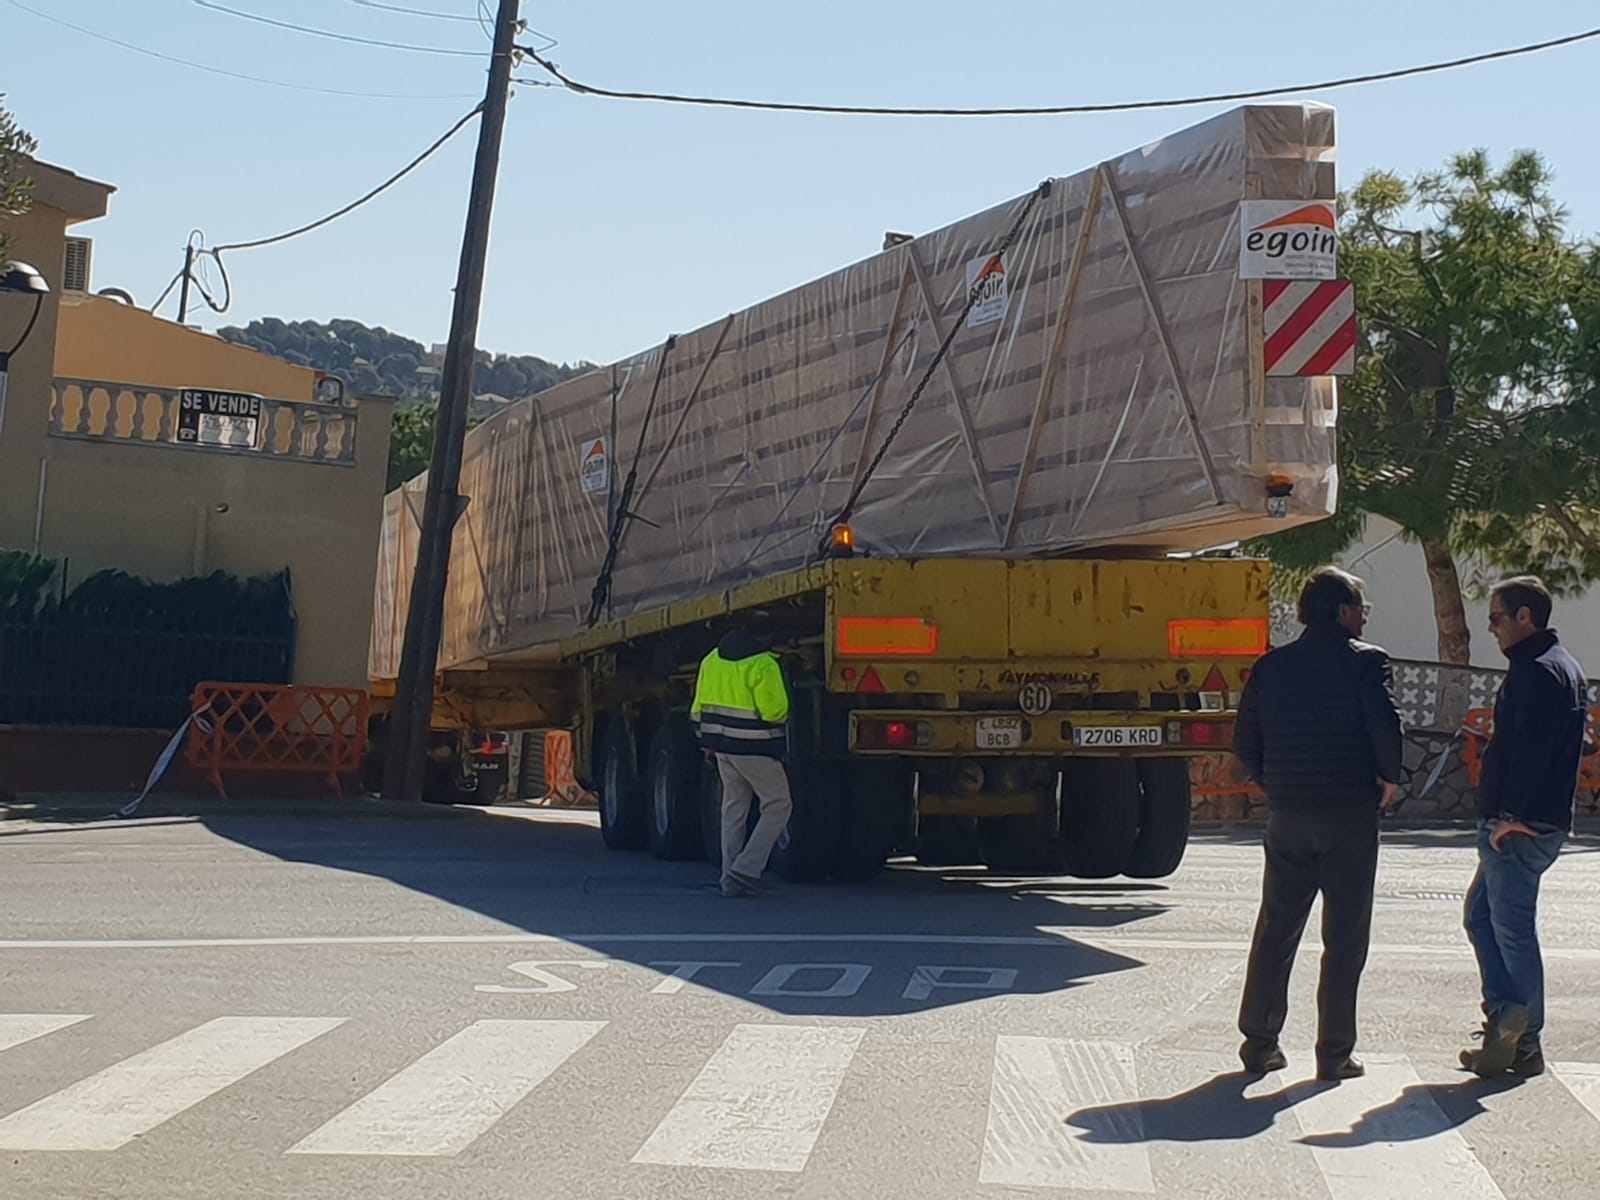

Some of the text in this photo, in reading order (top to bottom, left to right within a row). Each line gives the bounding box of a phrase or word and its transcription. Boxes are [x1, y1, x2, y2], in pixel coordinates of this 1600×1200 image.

[1246, 226, 1335, 258] egoin
[182, 391, 259, 415] SE VENDE
[1023, 685, 1047, 711] 60
[1084, 728, 1157, 745] 2706 KRD
[474, 959, 1018, 1000] STOP
